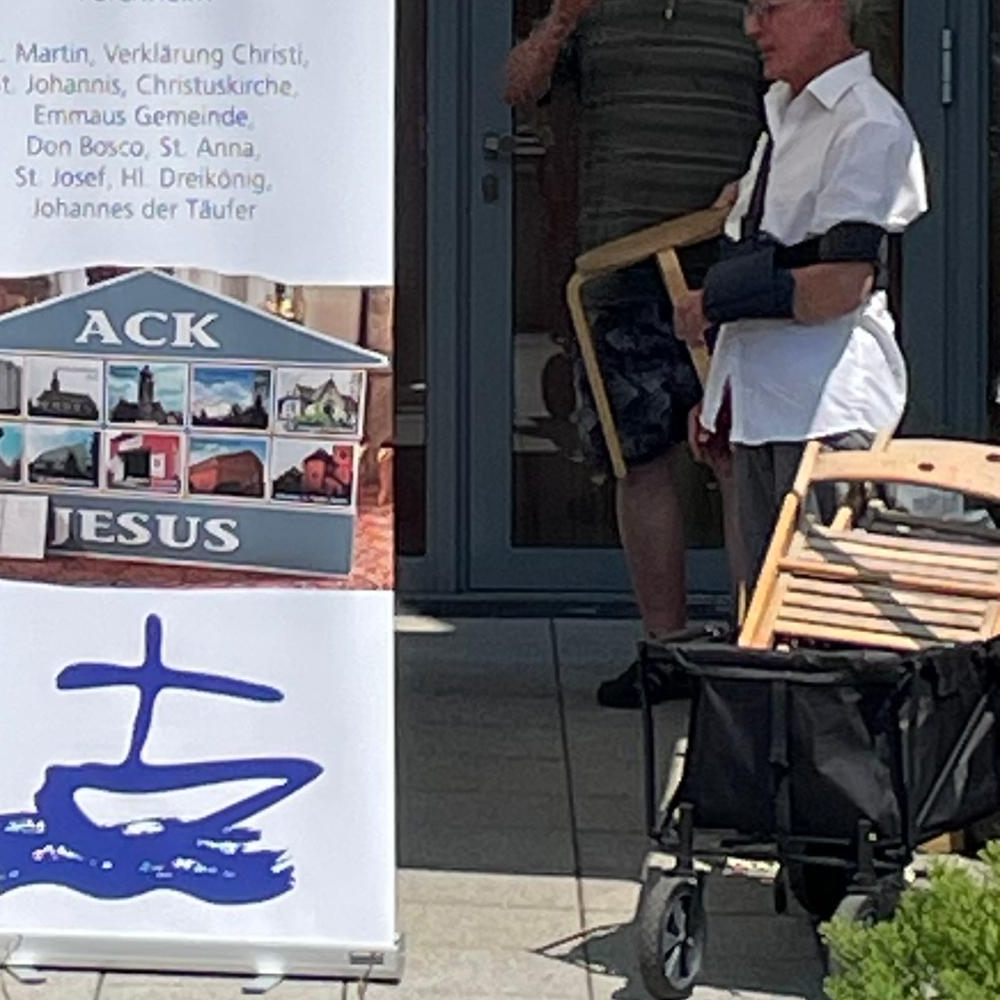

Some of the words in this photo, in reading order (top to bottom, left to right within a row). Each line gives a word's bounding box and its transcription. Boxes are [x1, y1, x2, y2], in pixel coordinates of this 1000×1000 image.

[16, 43, 95, 67] Martin,
[103, 43, 223, 69] Verklärung
[232, 43, 309, 68] Christi,
[25, 74, 126, 97] Johannis,
[136, 75, 298, 98] Christuskirche,
[34, 105, 126, 126] Emmaus
[134, 105, 255, 130] Gemeinde,
[27, 136, 71, 157] Don
[80, 136, 149, 160] Bosco,
[197, 137, 261, 161] Anna,
[50, 167, 112, 191] Josef,
[160, 167, 273, 194] Dreikönig,
[32, 198, 133, 219] Johannes
[142, 198, 178, 220] der
[185, 198, 257, 220] Täufer
[75, 309, 221, 349] ACK
[51, 506, 241, 554] JESUS
